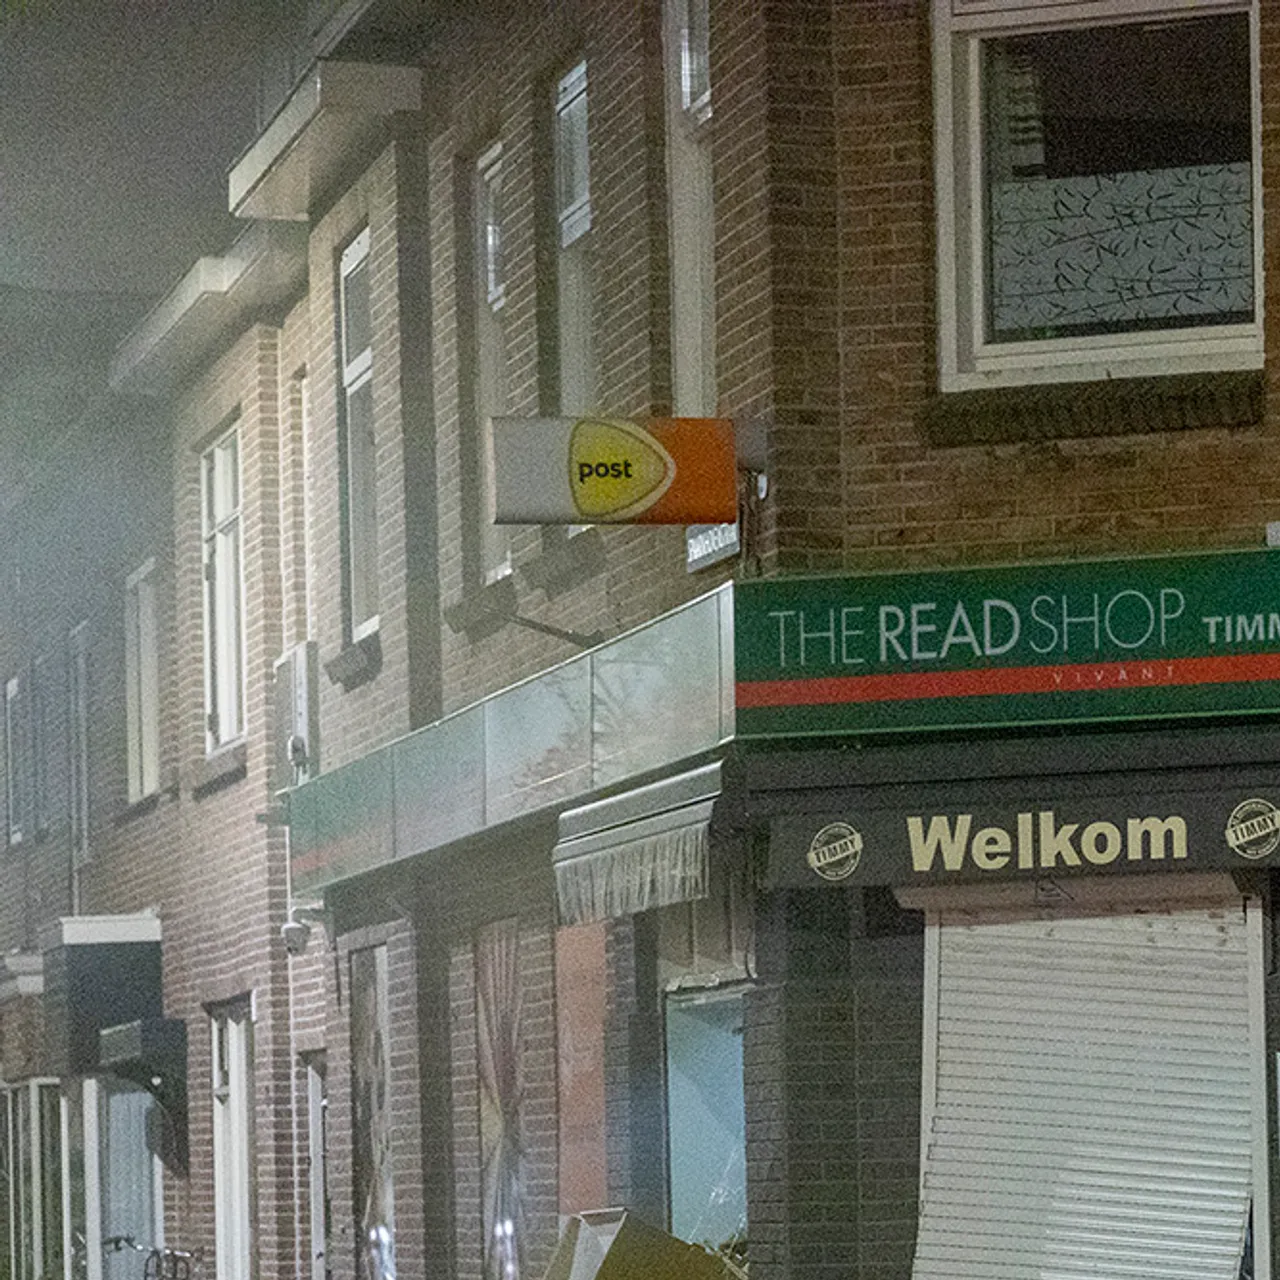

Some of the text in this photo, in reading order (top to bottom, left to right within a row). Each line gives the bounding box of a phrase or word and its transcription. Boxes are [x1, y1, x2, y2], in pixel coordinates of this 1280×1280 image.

[577, 457, 633, 484] post
[769, 606, 865, 667] THE
[878, 597, 1021, 662] READ
[1029, 588, 1186, 655] SHOP
[1053, 664, 1177, 684] VIVANT
[906, 810, 1188, 872] Welkom
[1232, 813, 1277, 842] TIMMY
[813, 836, 857, 864] TIMMY
